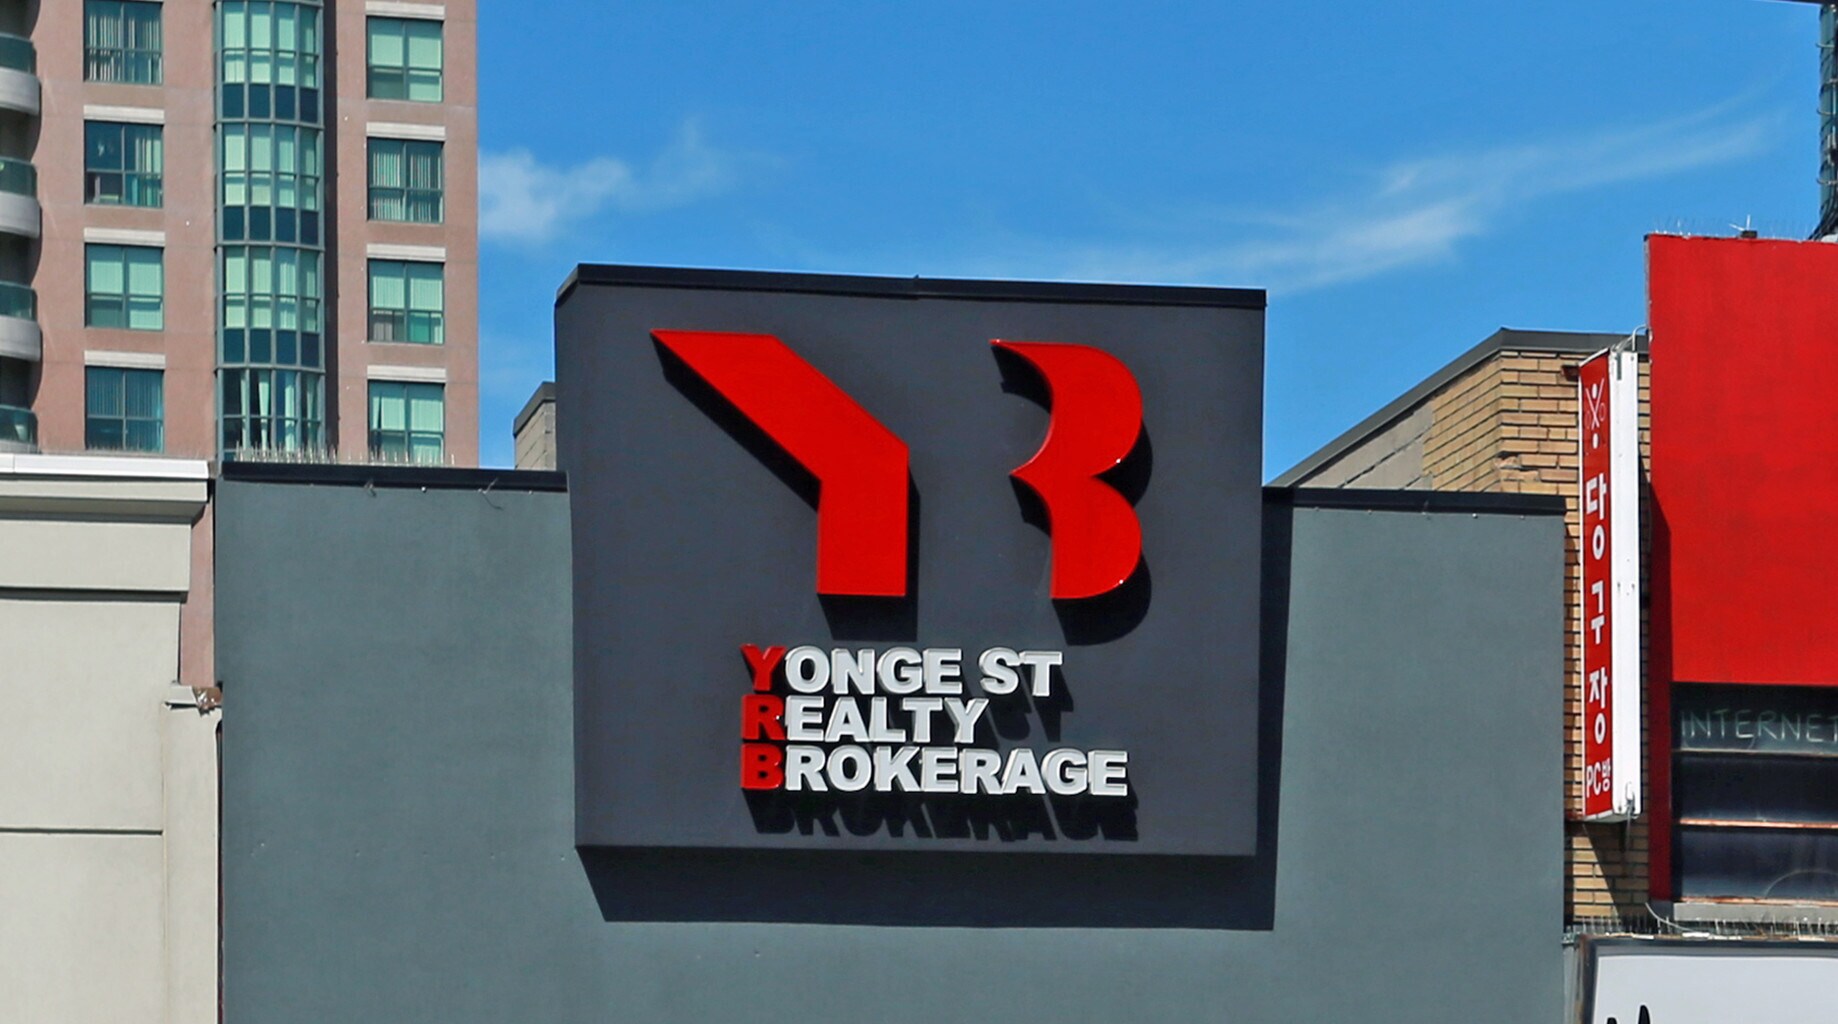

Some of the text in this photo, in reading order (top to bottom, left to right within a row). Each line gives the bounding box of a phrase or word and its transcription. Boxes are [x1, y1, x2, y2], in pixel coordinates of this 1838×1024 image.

[740, 644, 1063, 697] YONGE ST
[740, 694, 988, 743] REALTY
[740, 744, 1128, 797] BROKERAGE
